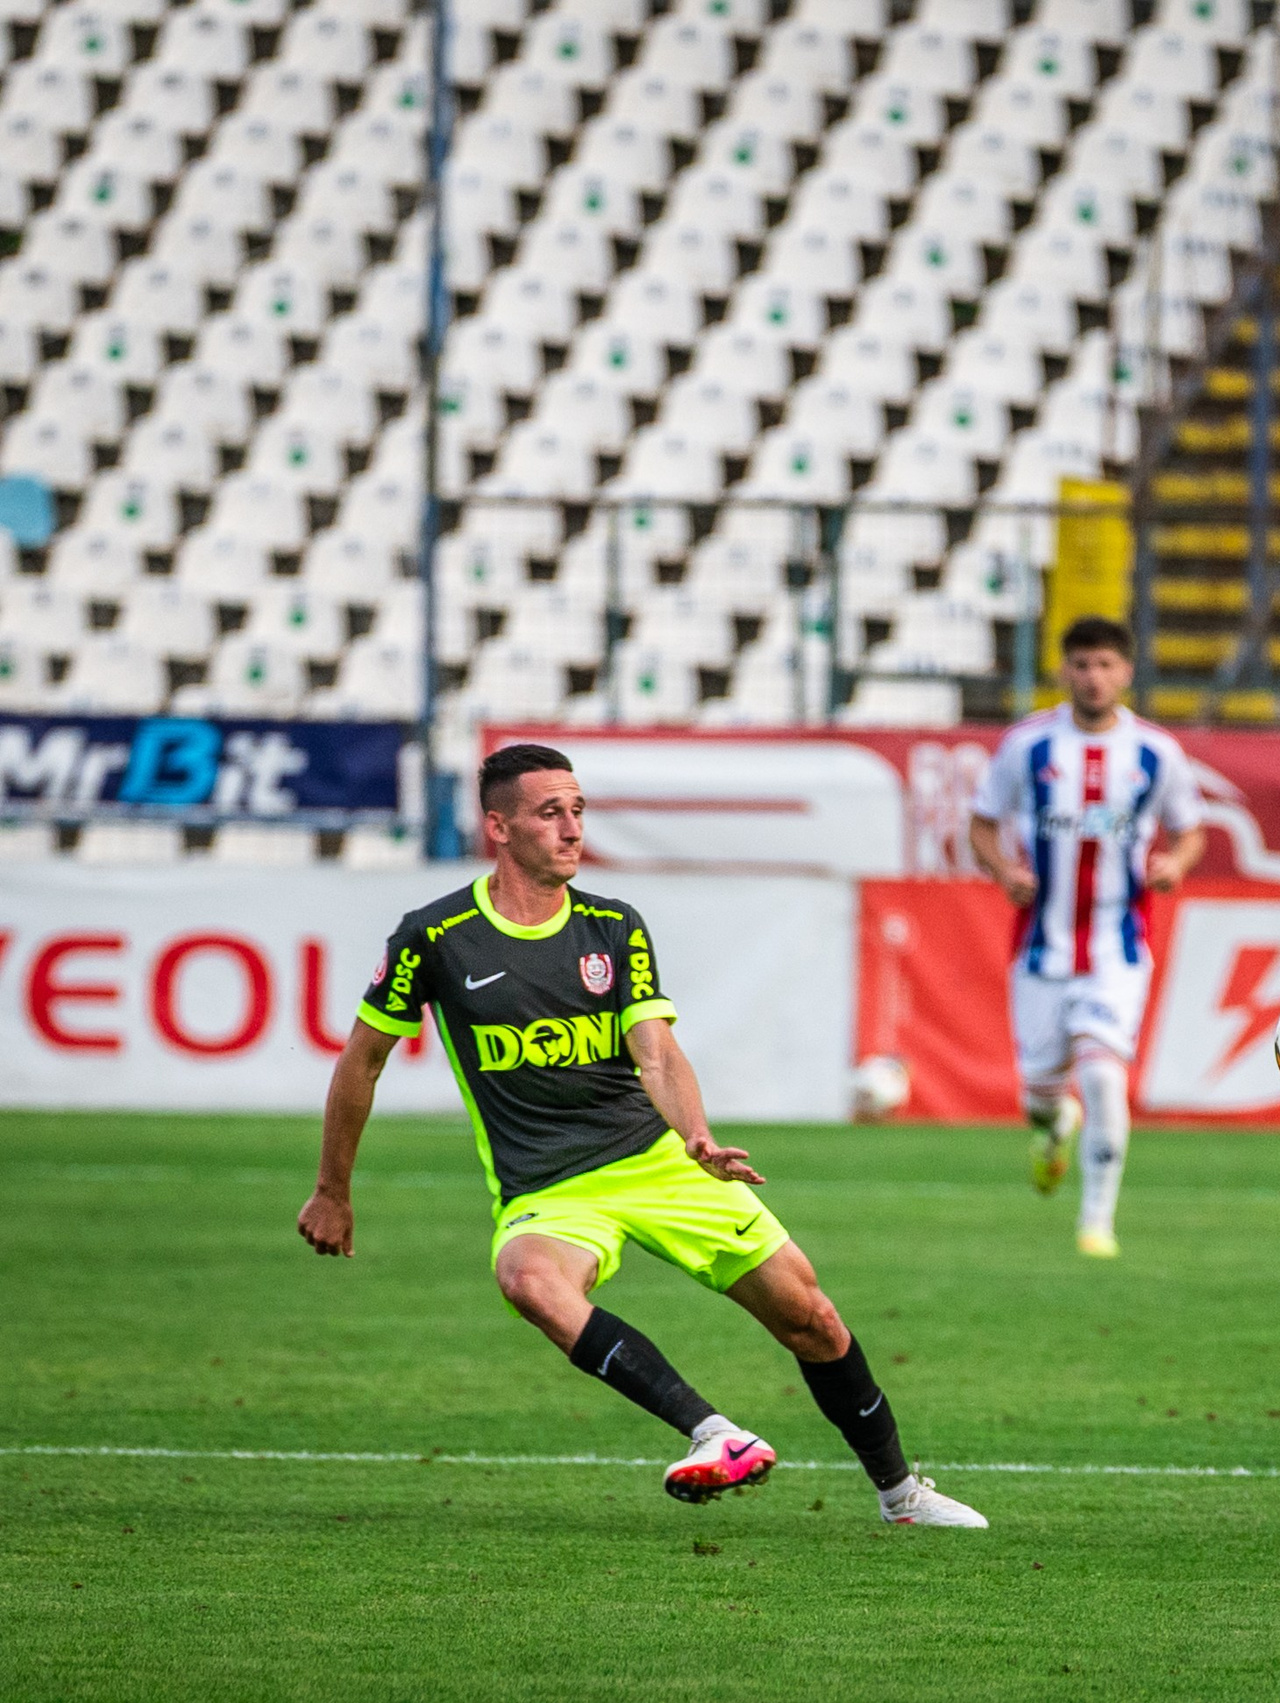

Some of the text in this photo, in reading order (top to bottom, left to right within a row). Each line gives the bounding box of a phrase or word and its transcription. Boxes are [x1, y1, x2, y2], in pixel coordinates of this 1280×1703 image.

[0, 717, 308, 814] MrBit
[0, 926, 428, 1061] EOL
[391, 947, 420, 995] DSC
[630, 952, 655, 1000] DSC
